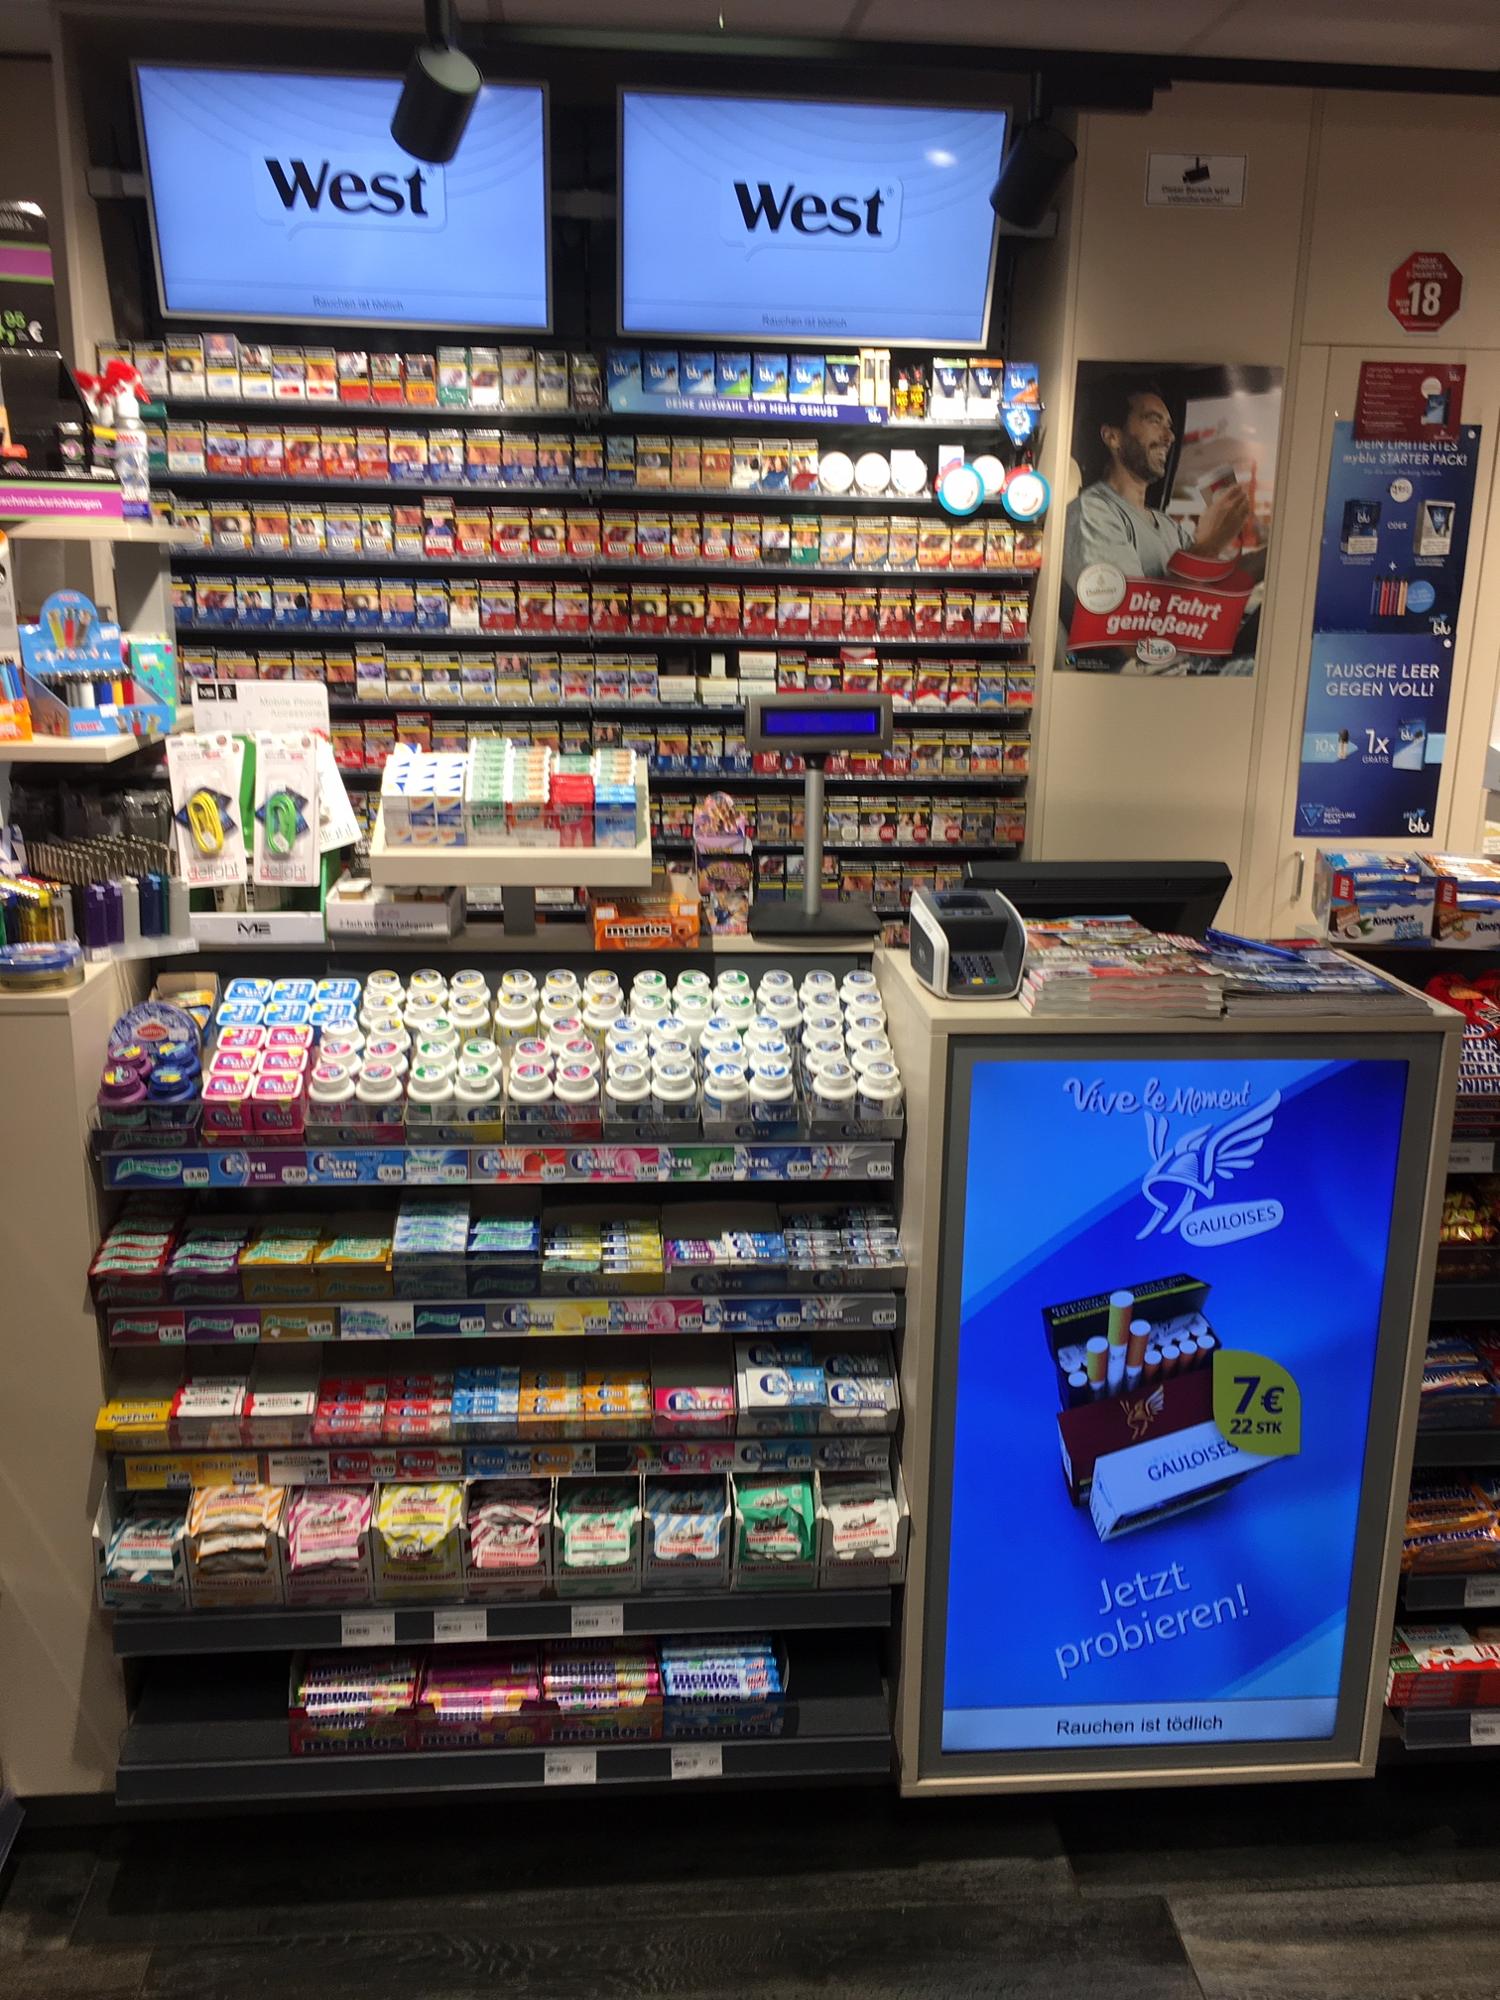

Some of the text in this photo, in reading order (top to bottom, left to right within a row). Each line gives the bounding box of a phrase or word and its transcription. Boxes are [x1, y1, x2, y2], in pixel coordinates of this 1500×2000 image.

[265, 158, 428, 217] West
[733, 180, 884, 237] West
[1408, 282, 1441, 316] 18
[666, 399, 839, 418] DEINE AUSWAHL FÜR MEHR GENUSS
[1379, 453, 1430, 465] STARTER
[1433, 454, 1468, 466] PACK!
[1129, 591, 1222, 621] Die Fahrt
[1107, 612, 1208, 640] genießen!
[1432, 621, 1451, 635] blu
[1325, 663, 1440, 679] TAUSCHE LEER
[1326, 682, 1435, 697] GEGEN VOLL!
[1365, 728, 1390, 754] 1x
[1408, 816, 1430, 834] blu
[605, 924, 672, 938] mentos
[1063, 1077, 1253, 1117] Vive le Moment
[1186, 1205, 1277, 1238] GAULOISES
[1229, 1418, 1282, 1435] 22 STK
[1147, 1440, 1239, 1482] GAULOISES
[1099, 1561, 1191, 1615] Jetzt
[1054, 1583, 1250, 1680] probieren!
[672, 1671, 740, 1684] mentos
[1057, 1715, 1223, 1736] Rauchen ist tödlich
